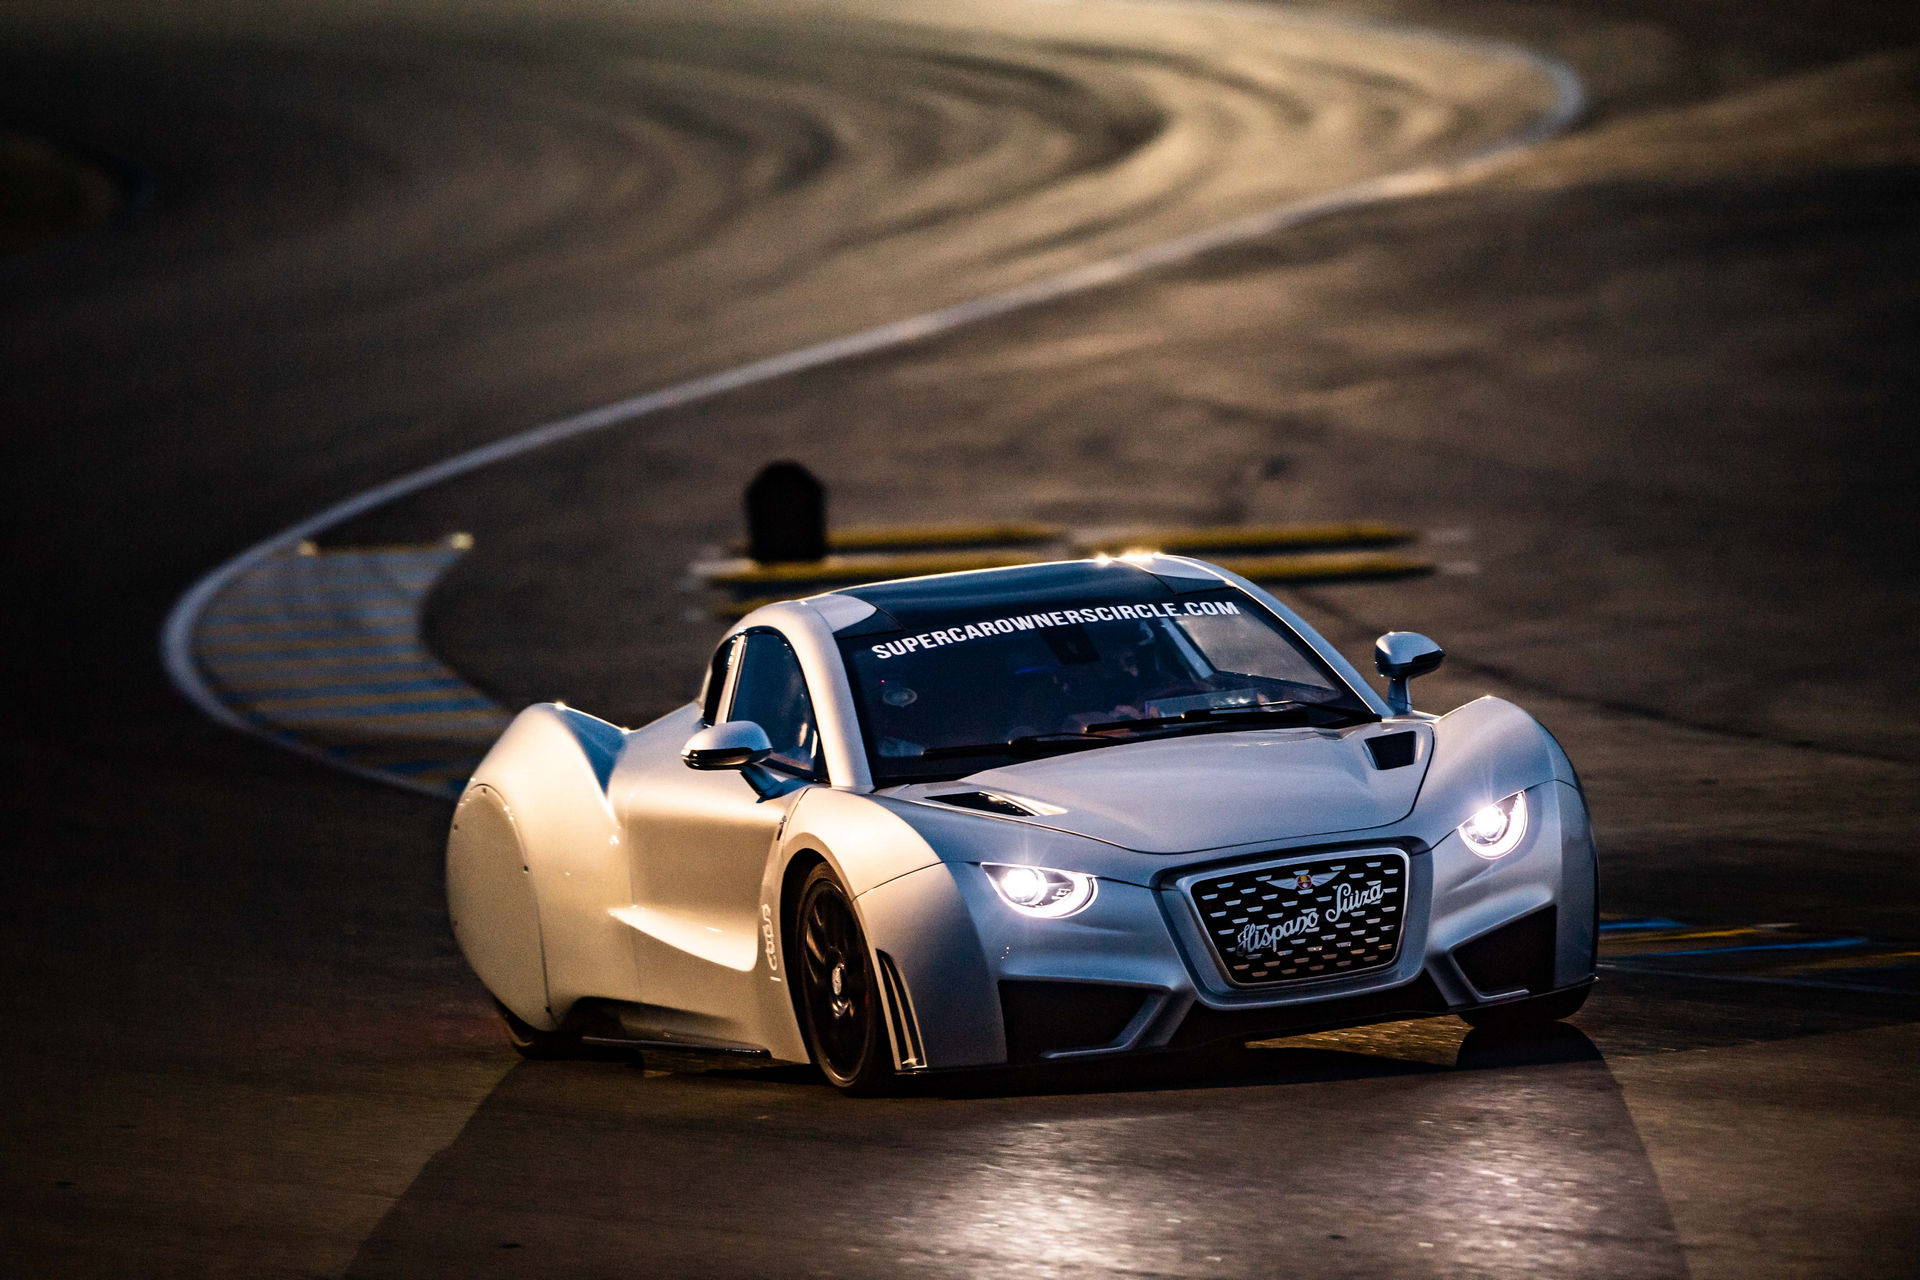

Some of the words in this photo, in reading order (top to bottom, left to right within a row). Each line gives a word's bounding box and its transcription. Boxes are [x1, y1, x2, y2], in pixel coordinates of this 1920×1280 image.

[871, 601, 1241, 660] SUPERCAROWNERSCIRCLE.COM
[1236, 911, 1319, 955] Hispano
[1325, 883, 1384, 922] Suiza
